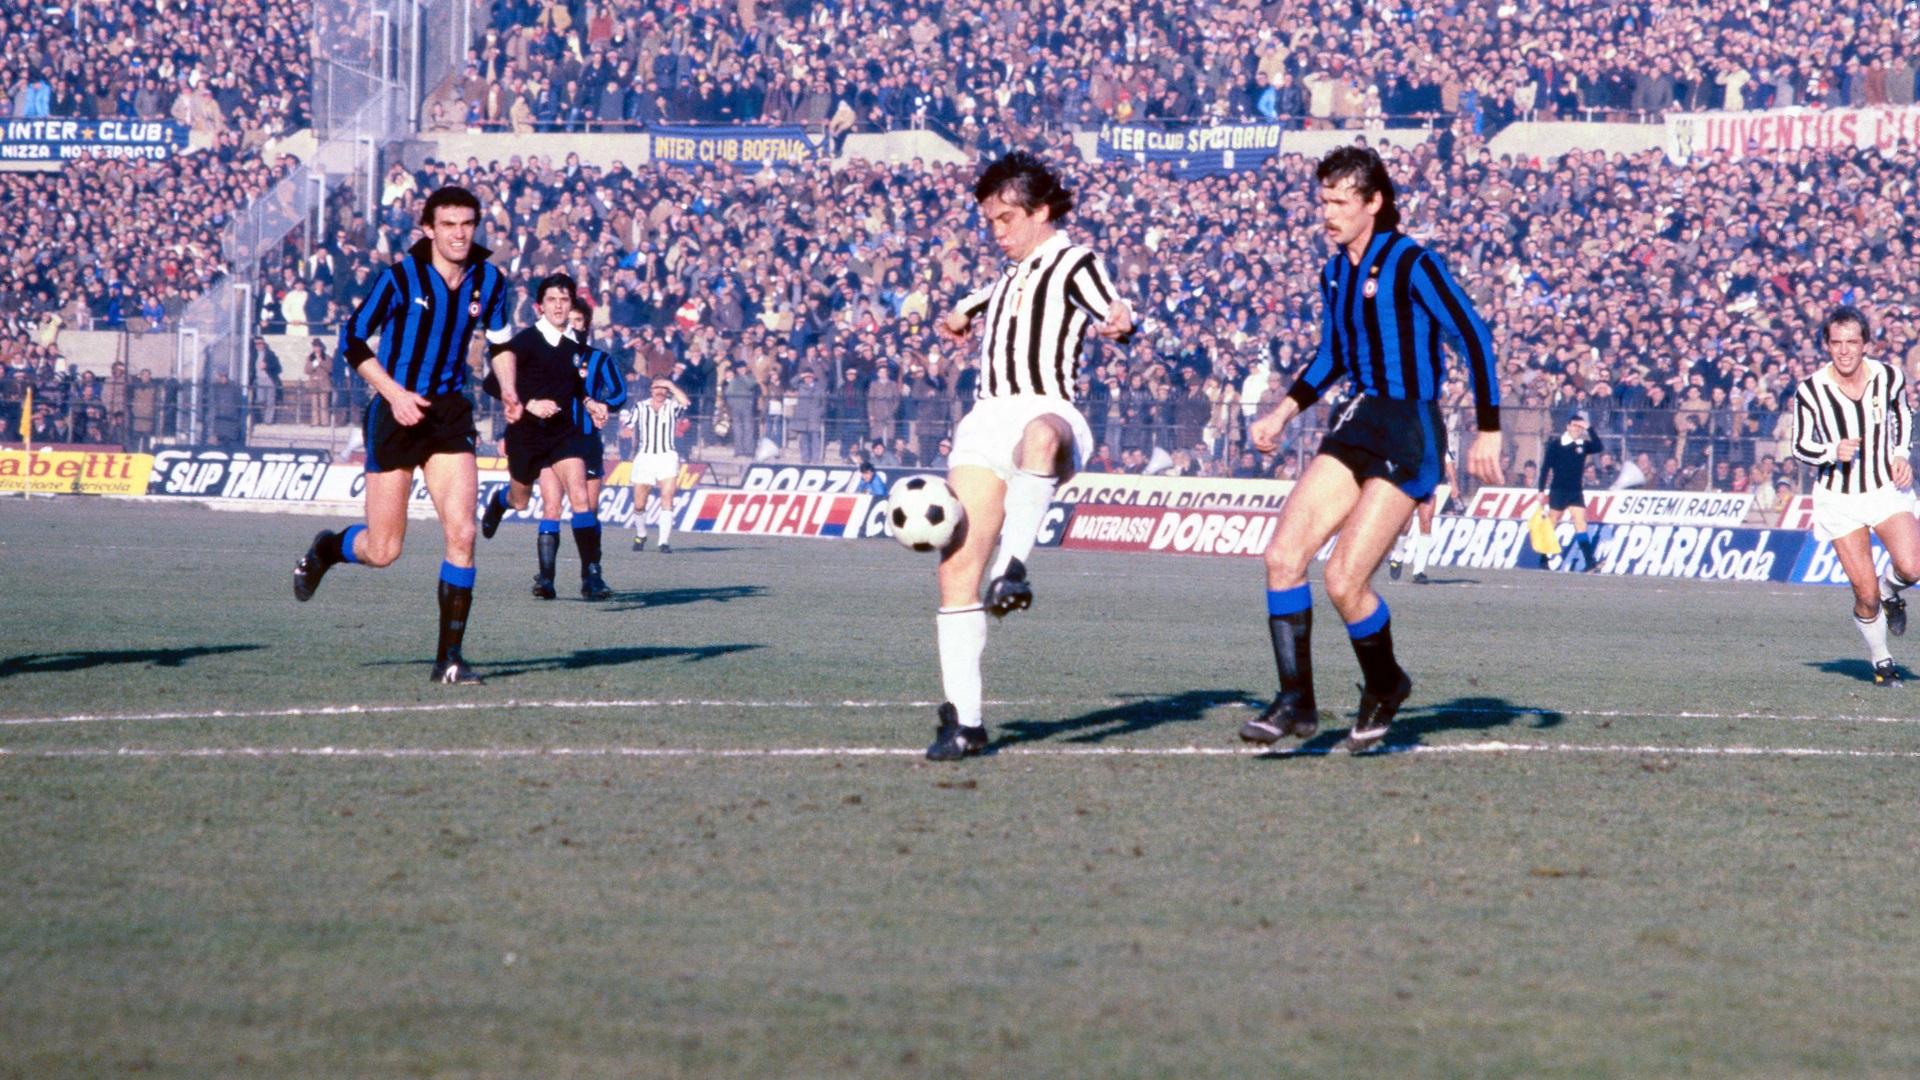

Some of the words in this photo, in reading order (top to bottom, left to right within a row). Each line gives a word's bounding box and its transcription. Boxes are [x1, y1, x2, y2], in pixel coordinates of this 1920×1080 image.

[8, 121, 78, 140] INTER
[99, 121, 163, 141] CLUB
[1148, 132, 1185, 149] CLUB
[1696, 113, 1858, 157] JUVENTUS
[1, 144, 50, 159] NIZZA
[655, 136, 696, 160] INTER
[0, 453, 133, 479] abetti
[165, 462, 224, 493] SLIP
[221, 461, 327, 500] TAMIGI
[721, 493, 823, 535] TOTAL
[1619, 496, 1684, 516] SISTEMI
[1686, 498, 1746, 518] RADAR
[1070, 514, 1155, 543] MATERASSI
[1700, 529, 1776, 582] Soda
